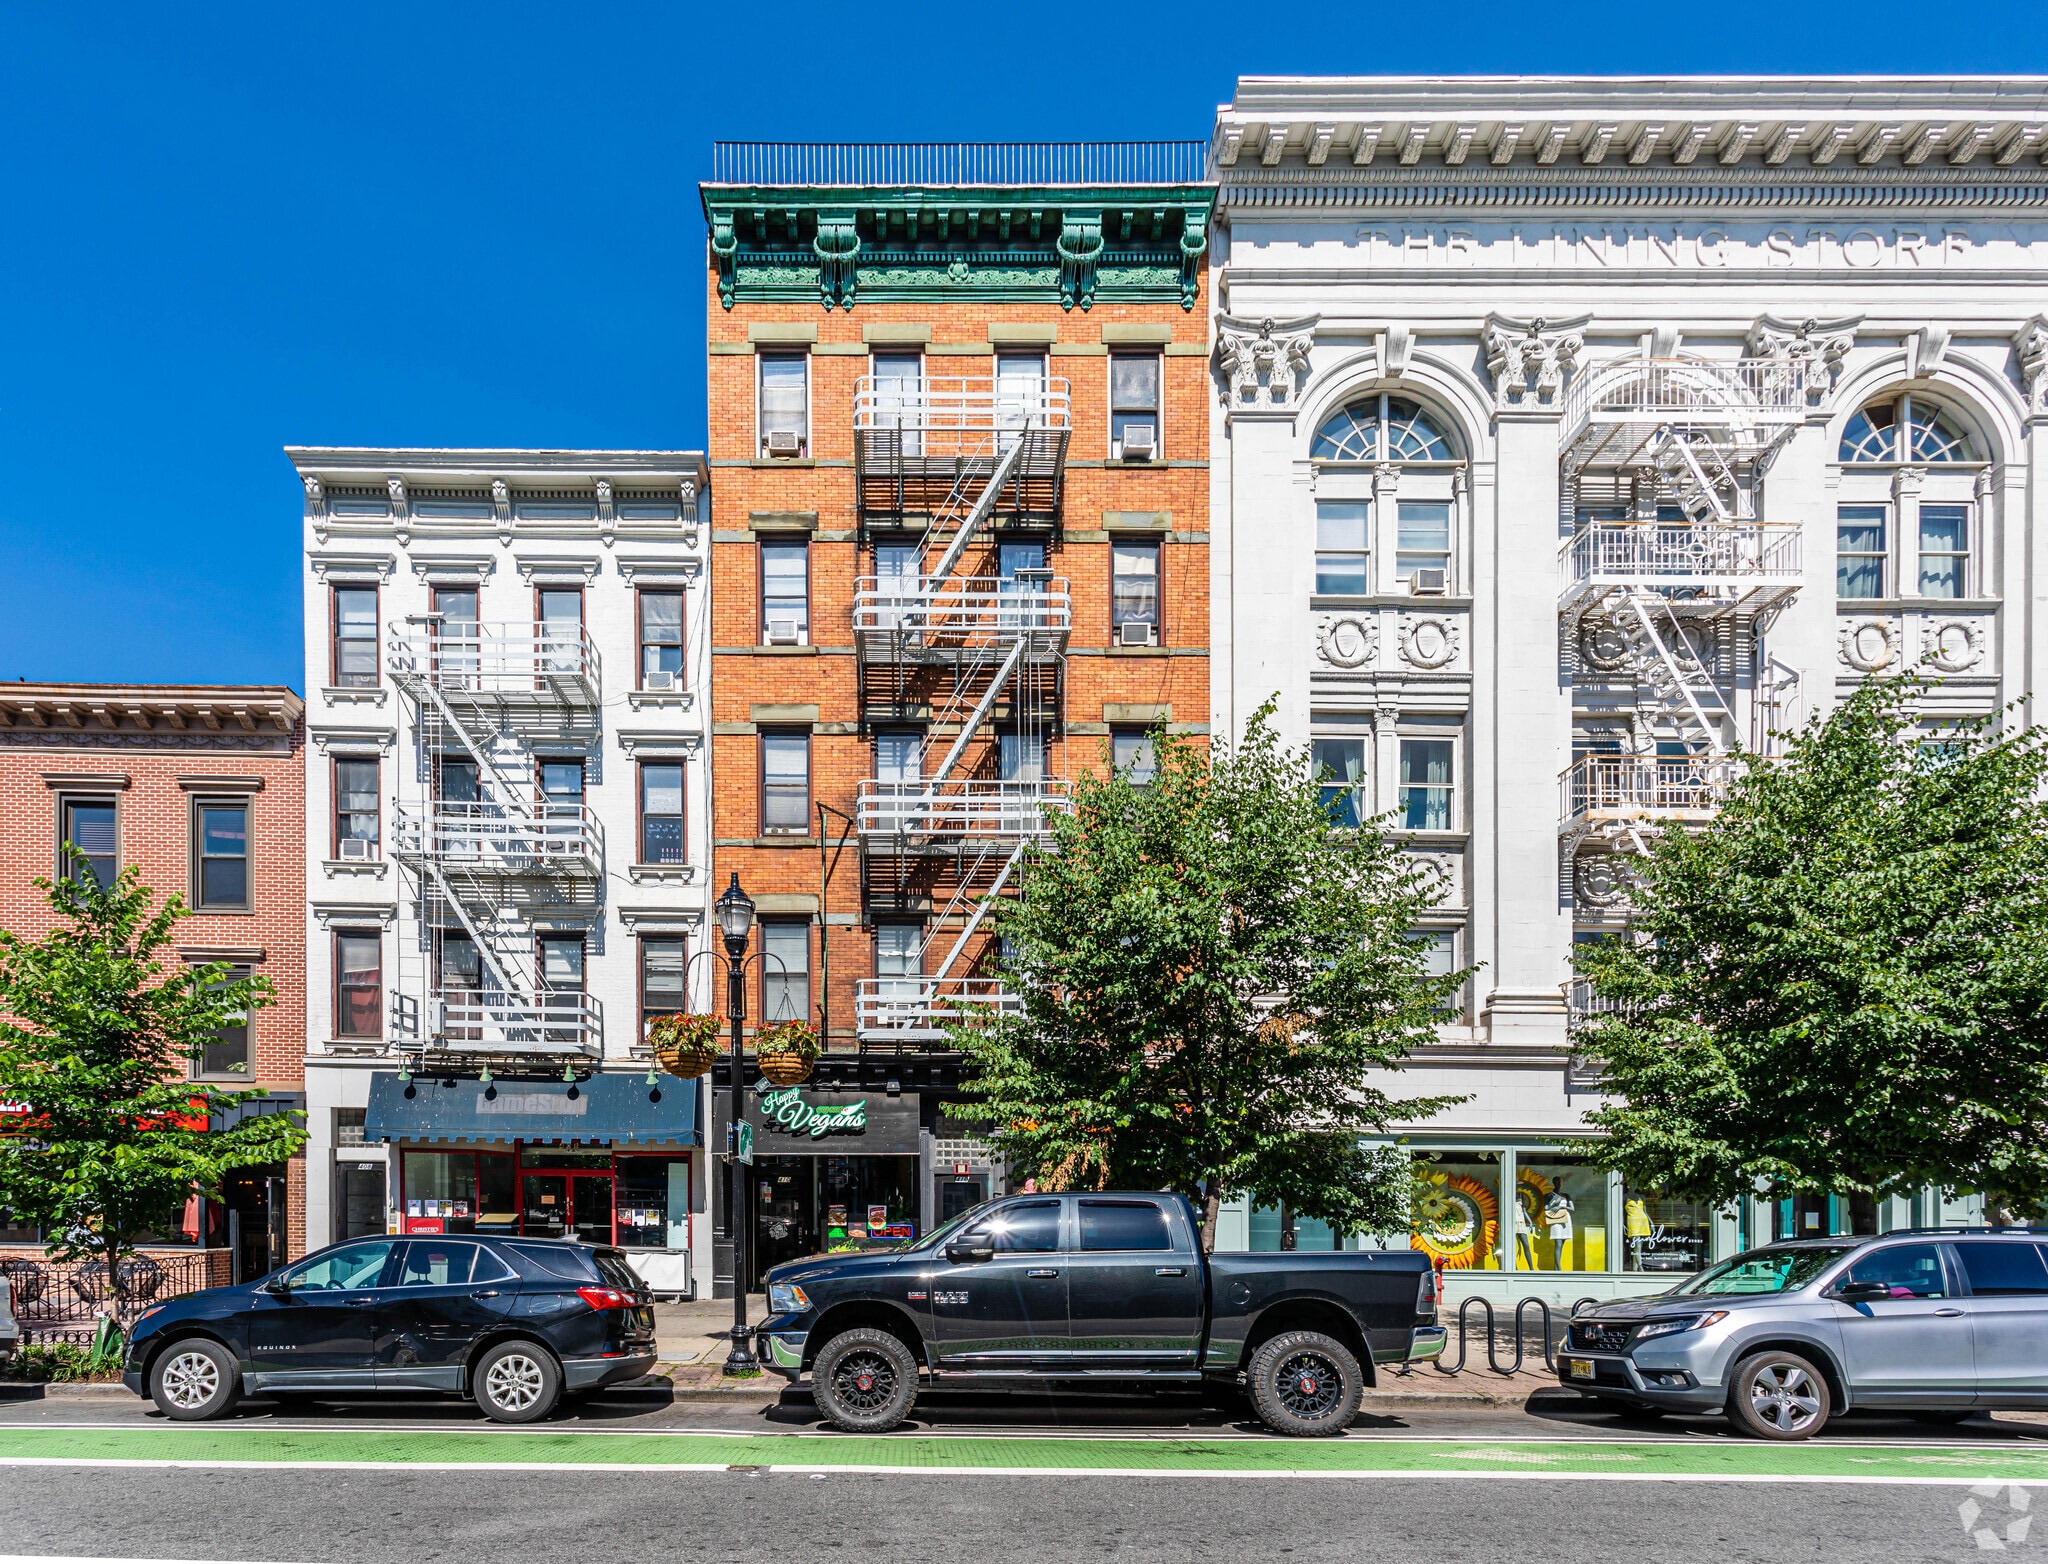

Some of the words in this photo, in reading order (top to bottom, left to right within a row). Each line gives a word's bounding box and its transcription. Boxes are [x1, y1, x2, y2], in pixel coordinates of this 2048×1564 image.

[761, 1087, 800, 1114] Happy
[777, 1100, 867, 1136] Vegans
[873, 1227, 910, 1236] OPEN
